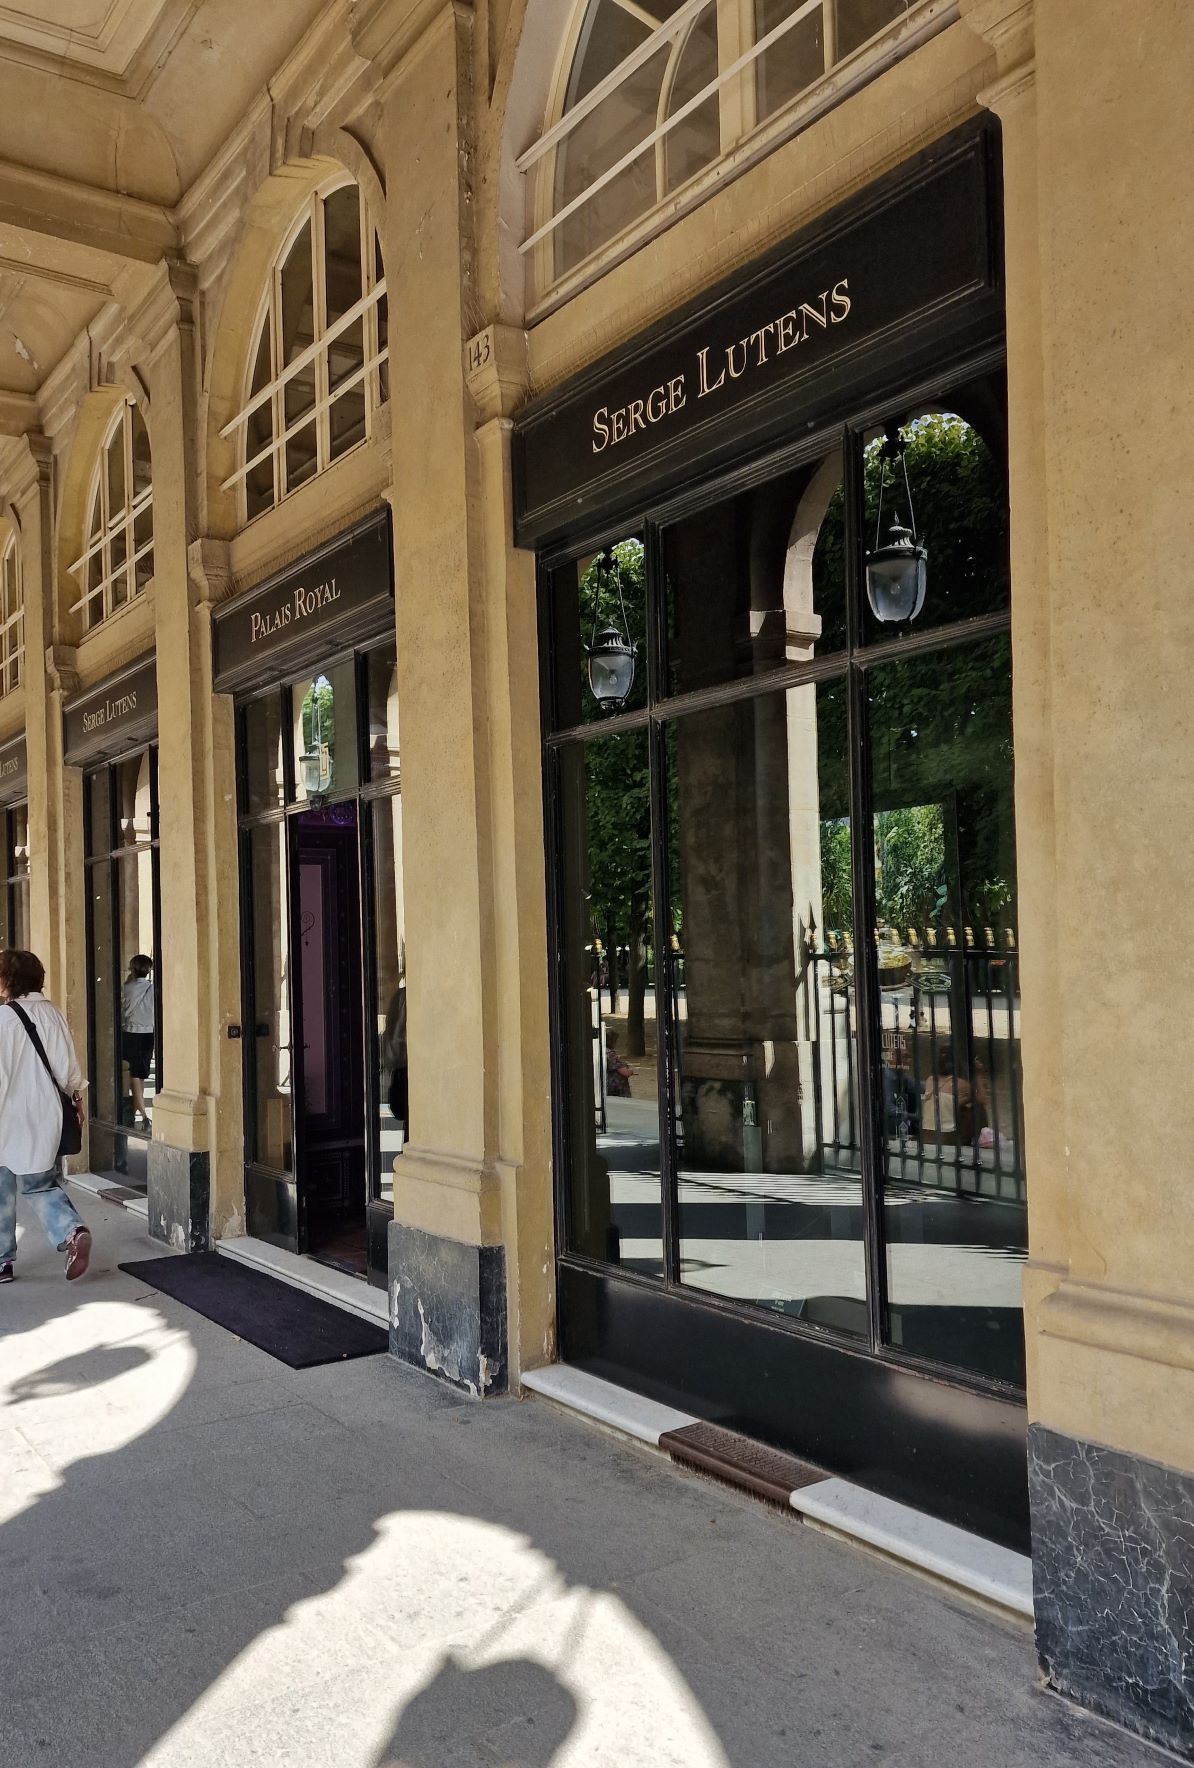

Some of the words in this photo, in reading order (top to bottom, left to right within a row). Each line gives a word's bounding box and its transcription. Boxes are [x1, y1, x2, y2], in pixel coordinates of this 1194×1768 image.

[469, 334, 490, 371] 143
[592, 374, 687, 453] SERGE
[697, 278, 851, 399] LUTENS
[250, 603, 292, 643] PALAIS
[293, 578, 341, 620] ROYAL
[82, 708, 105, 733] SERGE
[106, 690, 137, 722] LUTENS
